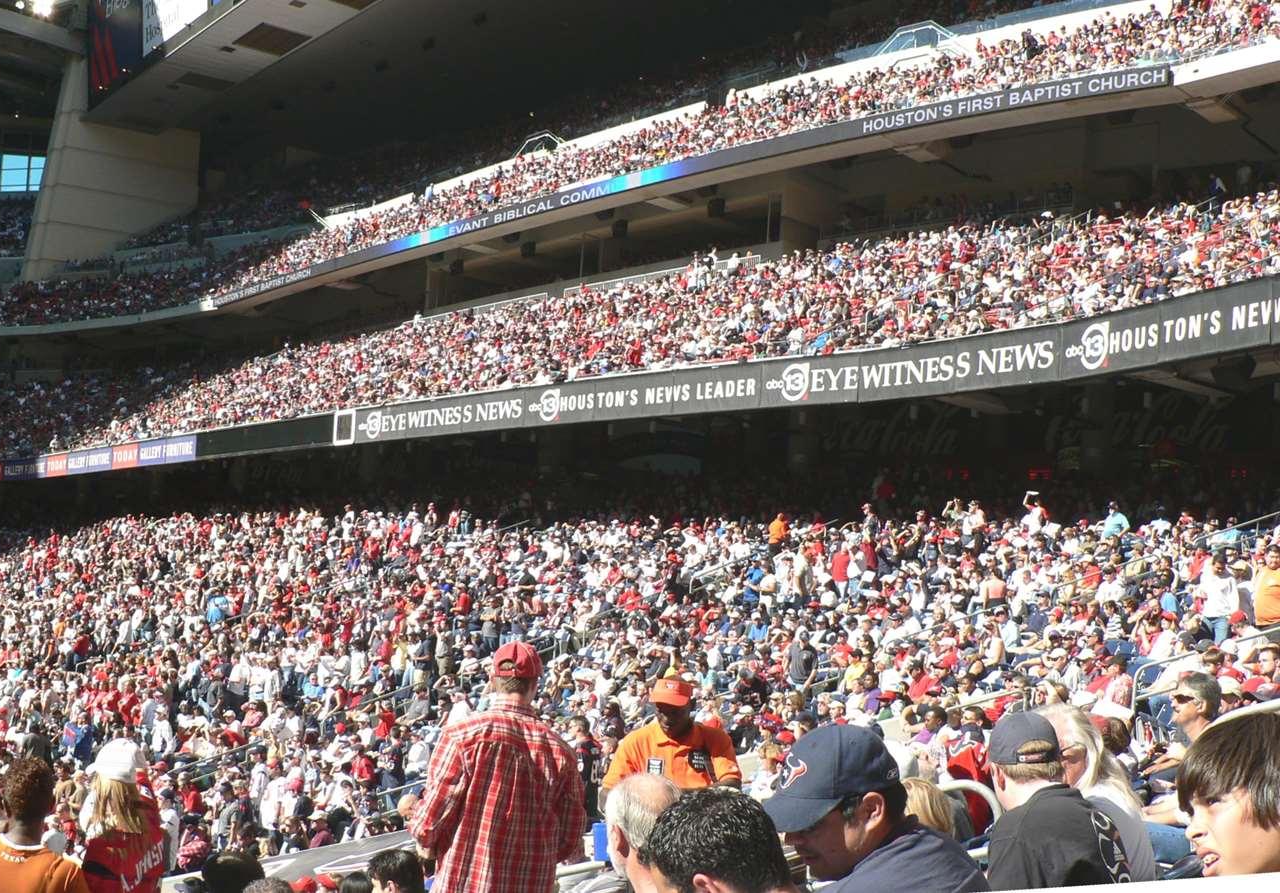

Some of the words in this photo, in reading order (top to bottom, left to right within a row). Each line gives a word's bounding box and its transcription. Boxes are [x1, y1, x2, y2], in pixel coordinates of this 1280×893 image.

[862, 103, 953, 134] HOUSTON'S
[958, 95, 1004, 115] FIRST
[1008, 81, 1083, 107] BAPTIST
[1088, 68, 1167, 93] CHURCH
[493, 200, 554, 224] BIBLICAL
[475, 398, 522, 422] NEWS
[696, 378, 756, 401] LEADER
[766, 379, 784, 391] abc
[976, 340, 1054, 376] NEWS
[1065, 344, 1085, 359] abc
[113, 449, 138, 463] TODAY
[140, 445, 162, 460] GALLERY
[162, 441, 193, 457] FURNITURE
